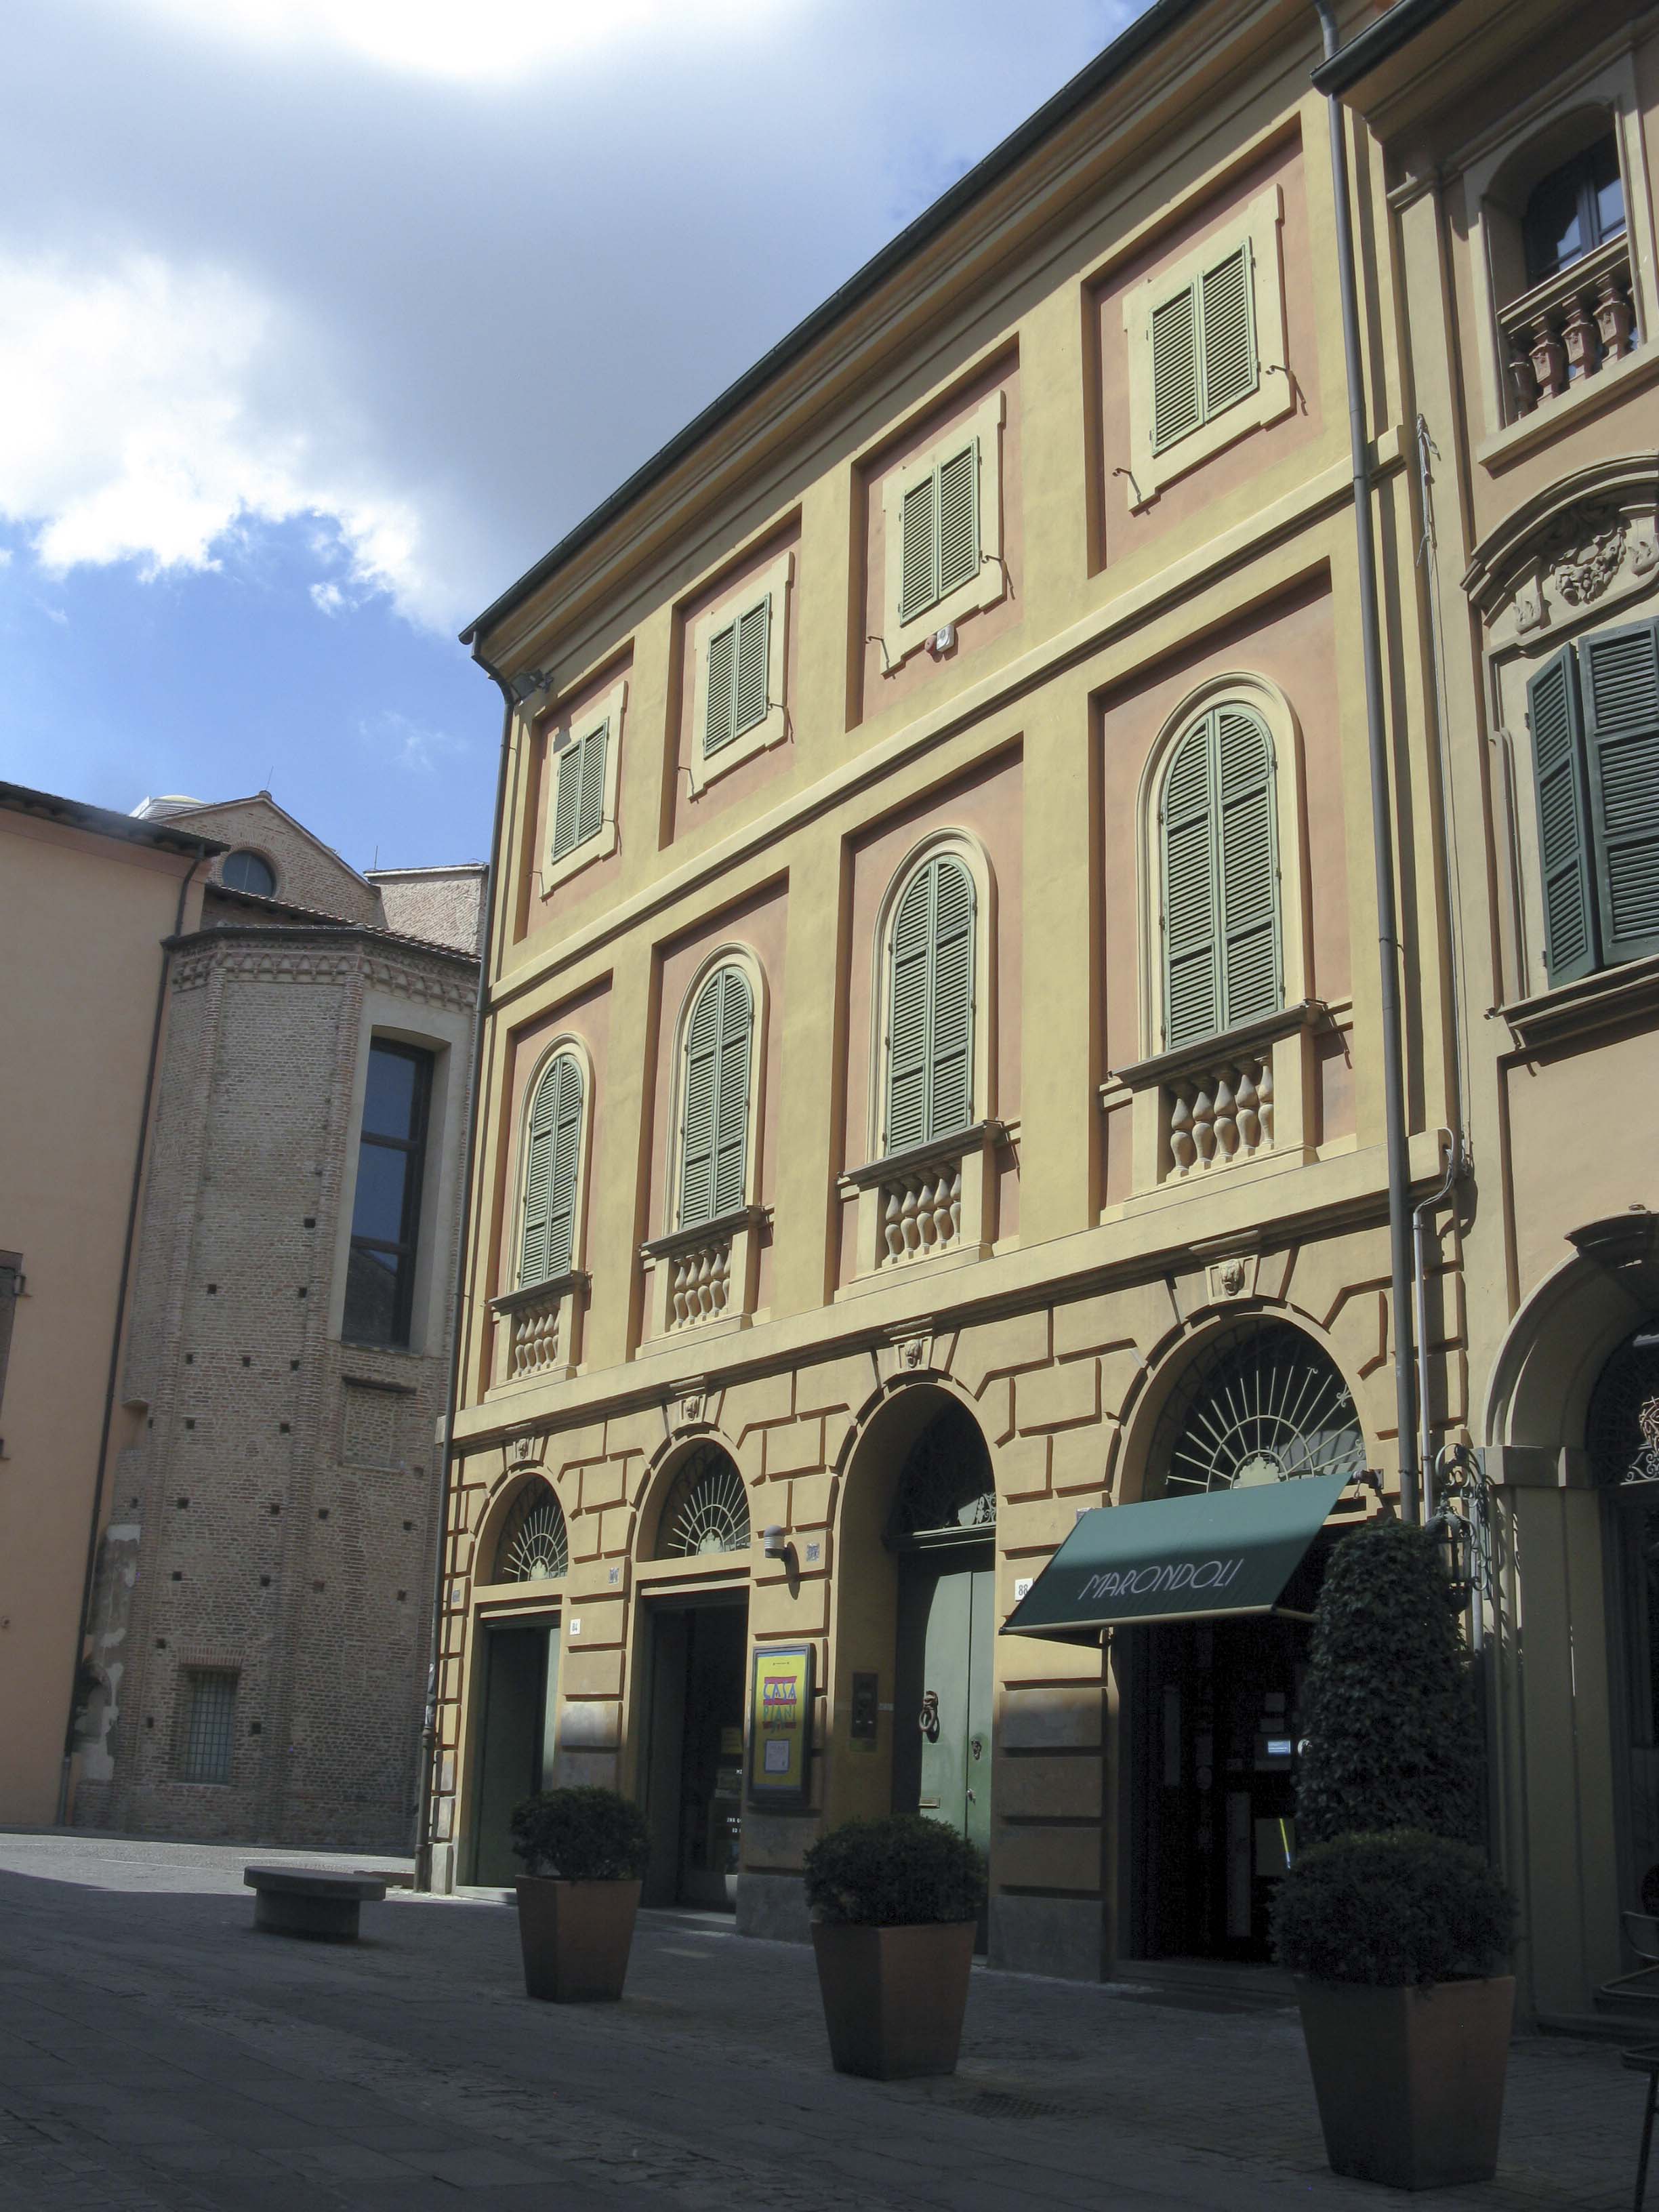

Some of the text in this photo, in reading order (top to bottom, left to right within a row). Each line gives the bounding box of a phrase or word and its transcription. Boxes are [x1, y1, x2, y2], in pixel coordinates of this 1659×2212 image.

[1078, 1558, 1244, 1599] MARONDOLI
[763, 1680, 797, 1702] CASA
[763, 1703, 797, 1733] PIANI
